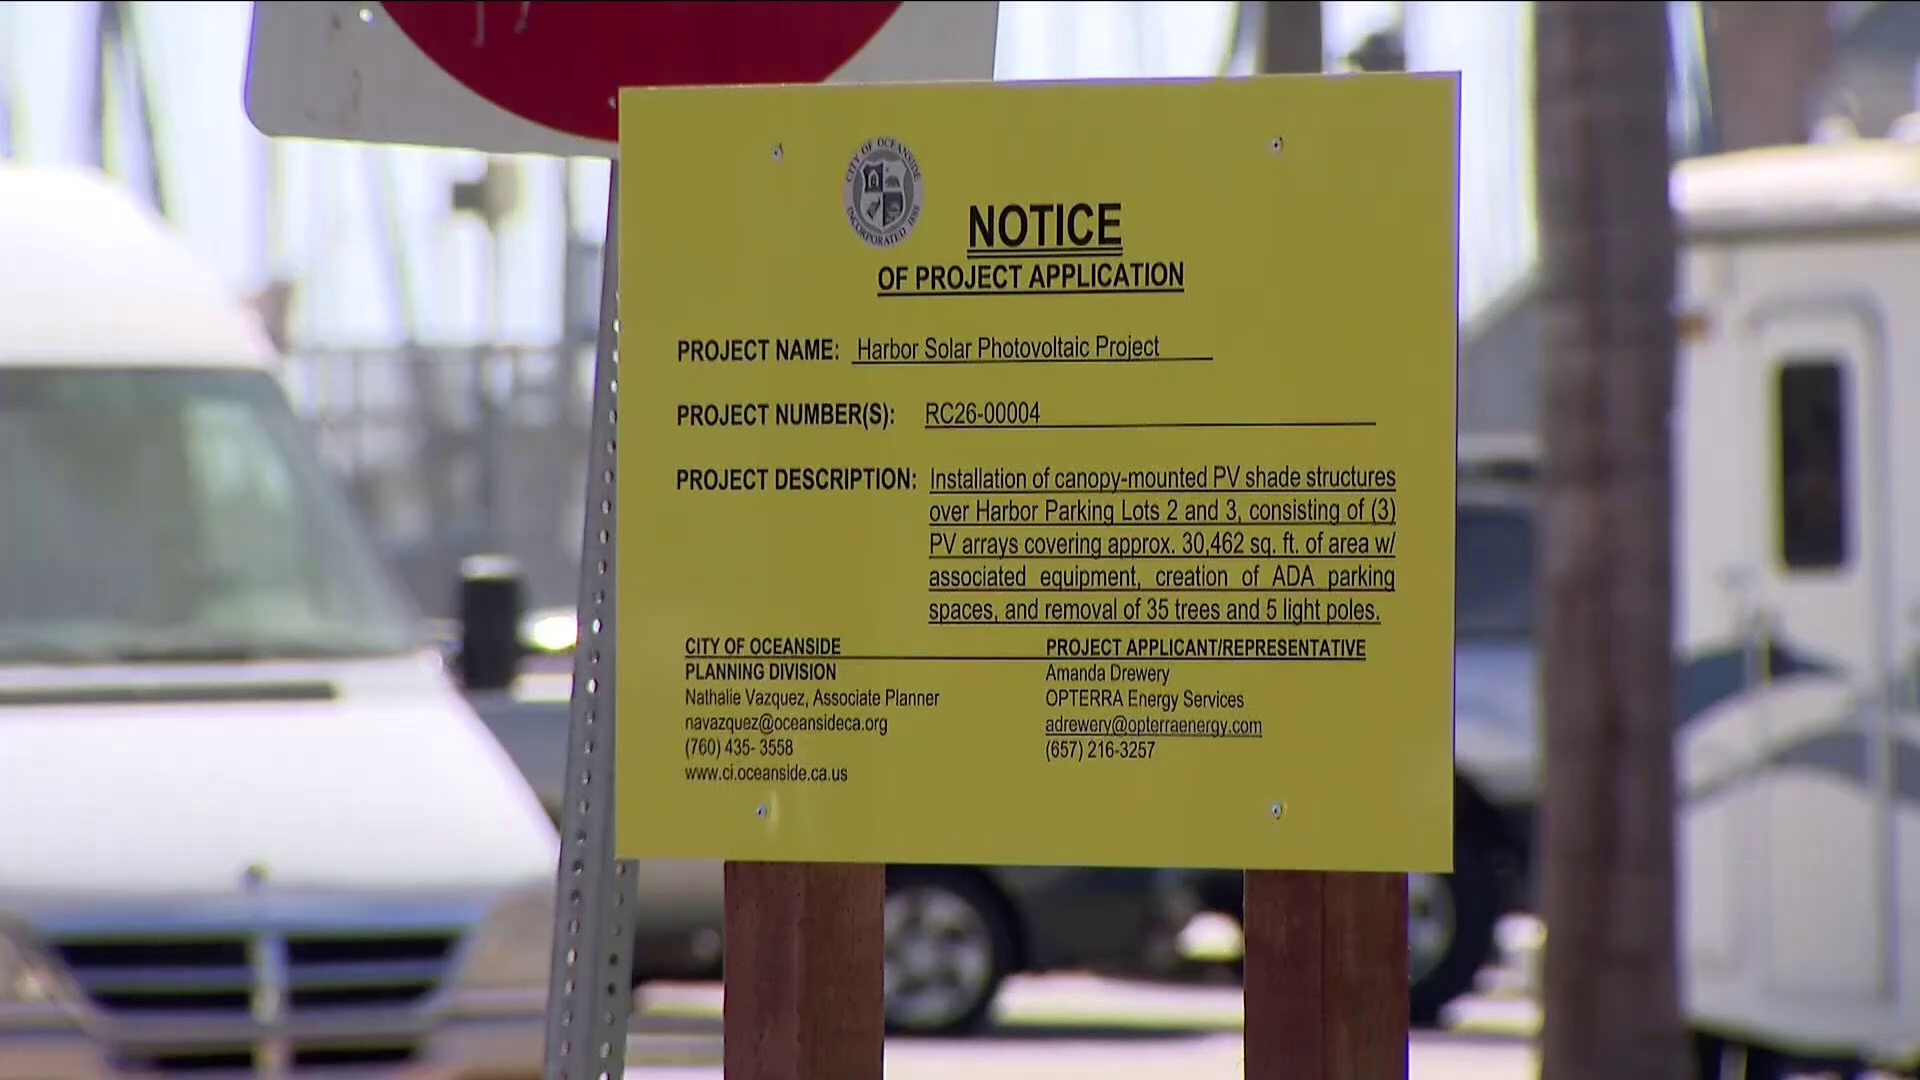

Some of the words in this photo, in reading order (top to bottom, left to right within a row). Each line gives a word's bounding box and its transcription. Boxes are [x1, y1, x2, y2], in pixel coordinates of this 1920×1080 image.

[846, 153, 860, 183] CITY
[861, 143, 873, 155] OF
[877, 138, 921, 183] OCEANSIDE
[847, 206, 906, 246] INCORPORATED
[970, 203, 1123, 247] NOTICE
[878, 266, 908, 290] OF
[916, 264, 1022, 290] PROJECT
[1029, 262, 1183, 288] APPLICATION
[678, 339, 770, 362] PROJECT
[776, 338, 839, 361] NAME:
[858, 337, 919, 360] Harbor
[925, 337, 972, 360] Solar
[979, 335, 1089, 358] Photovoltaic
[1096, 335, 1159, 363] Project
[678, 403, 769, 426] PROJECT
[776, 402, 894, 430] NUMBER(S):
[926, 401, 1040, 424] RC26-00004
[677, 468, 768, 490] PROJECT
[776, 467, 916, 490] DESCRIPTION:
[931, 467, 1026, 489] Installation
[1033, 466, 1050, 488] of
[1055, 466, 1207, 494] canopy-mounted
[1214, 465, 1240, 488] PV
[1246, 465, 1300, 488] shade
[1307, 465, 1396, 487] structures
[930, 505, 969, 522] over
[977, 499, 1038, 522] Harbor
[1046, 499, 1113, 528] Parking
[1122, 499, 1159, 521] Lots
[1167, 499, 1177, 520] 2
[1185, 498, 1218, 521] and
[1226, 499, 1241, 525] 3,
[1250, 498, 1339, 527] consisting
[1347, 497, 1365, 520] of
[1372, 497, 1395, 525] (3)
[931, 532, 956, 554] PV
[963, 537, 1018, 559] arrays
[1025, 532, 1101, 560] covering
[1108, 537, 1175, 559] approx.
[1183, 531, 1244, 557] 30,462
[1251, 537, 1276, 560] sq.
[1283, 531, 1298, 554] ft.
[1306, 531, 1324, 554] of
[1329, 537, 1368, 554] area
[1375, 531, 1396, 554] w/
[930, 565, 1025, 586] associated
[1040, 565, 1140, 592] equipment,
[1156, 565, 1227, 586] creation
[1242, 564, 1260, 586] of
[1272, 564, 1314, 586] ADA
[1329, 564, 1394, 592] parking
[929, 603, 997, 626] spaces,
[1005, 598, 1038, 620] and
[1046, 597, 1116, 620] removal
[1124, 597, 1142, 620] of
[1147, 597, 1168, 620] 35
[1175, 598, 1220, 620] trees
[1227, 598, 1259, 620] and
[1267, 598, 1277, 620] 5
[1284, 597, 1320, 626] light
[1327, 597, 1379, 626] poles.
[686, 638, 720, 654] CITY
[725, 638, 745, 654] OF
[750, 637, 840, 655] OCEANSIDE
[1047, 638, 1122, 656] PROJECT
[1127, 639, 1366, 656] APPLICANT/REPRESENTATIVE
[686, 663, 764, 680] PLANNING
[770, 663, 836, 680] DIVISION
[1046, 664, 1105, 682] Amanda
[1111, 664, 1169, 686] Drewery
[686, 688, 741, 706] Nathalie
[745, 688, 808, 710] Vazquez,
[813, 688, 880, 706] Associate
[886, 689, 940, 706] Planner
[1046, 689, 1123, 707] OPTERRA
[1129, 689, 1179, 712] Energy
[1184, 689, 1244, 708] Services
[686, 713, 887, 736] navazquez@oceansideca.org
[1046, 715, 1262, 738] adrewery@opterraenergy.com
[686, 738, 720, 760] (760)
[725, 738, 755, 756] 435-
[760, 738, 793, 756] 3558
[1046, 740, 1083, 762] (657)
[1088, 740, 1155, 758] 216-3257
[685, 763, 847, 782] www.ci.oceanside.ca.us
